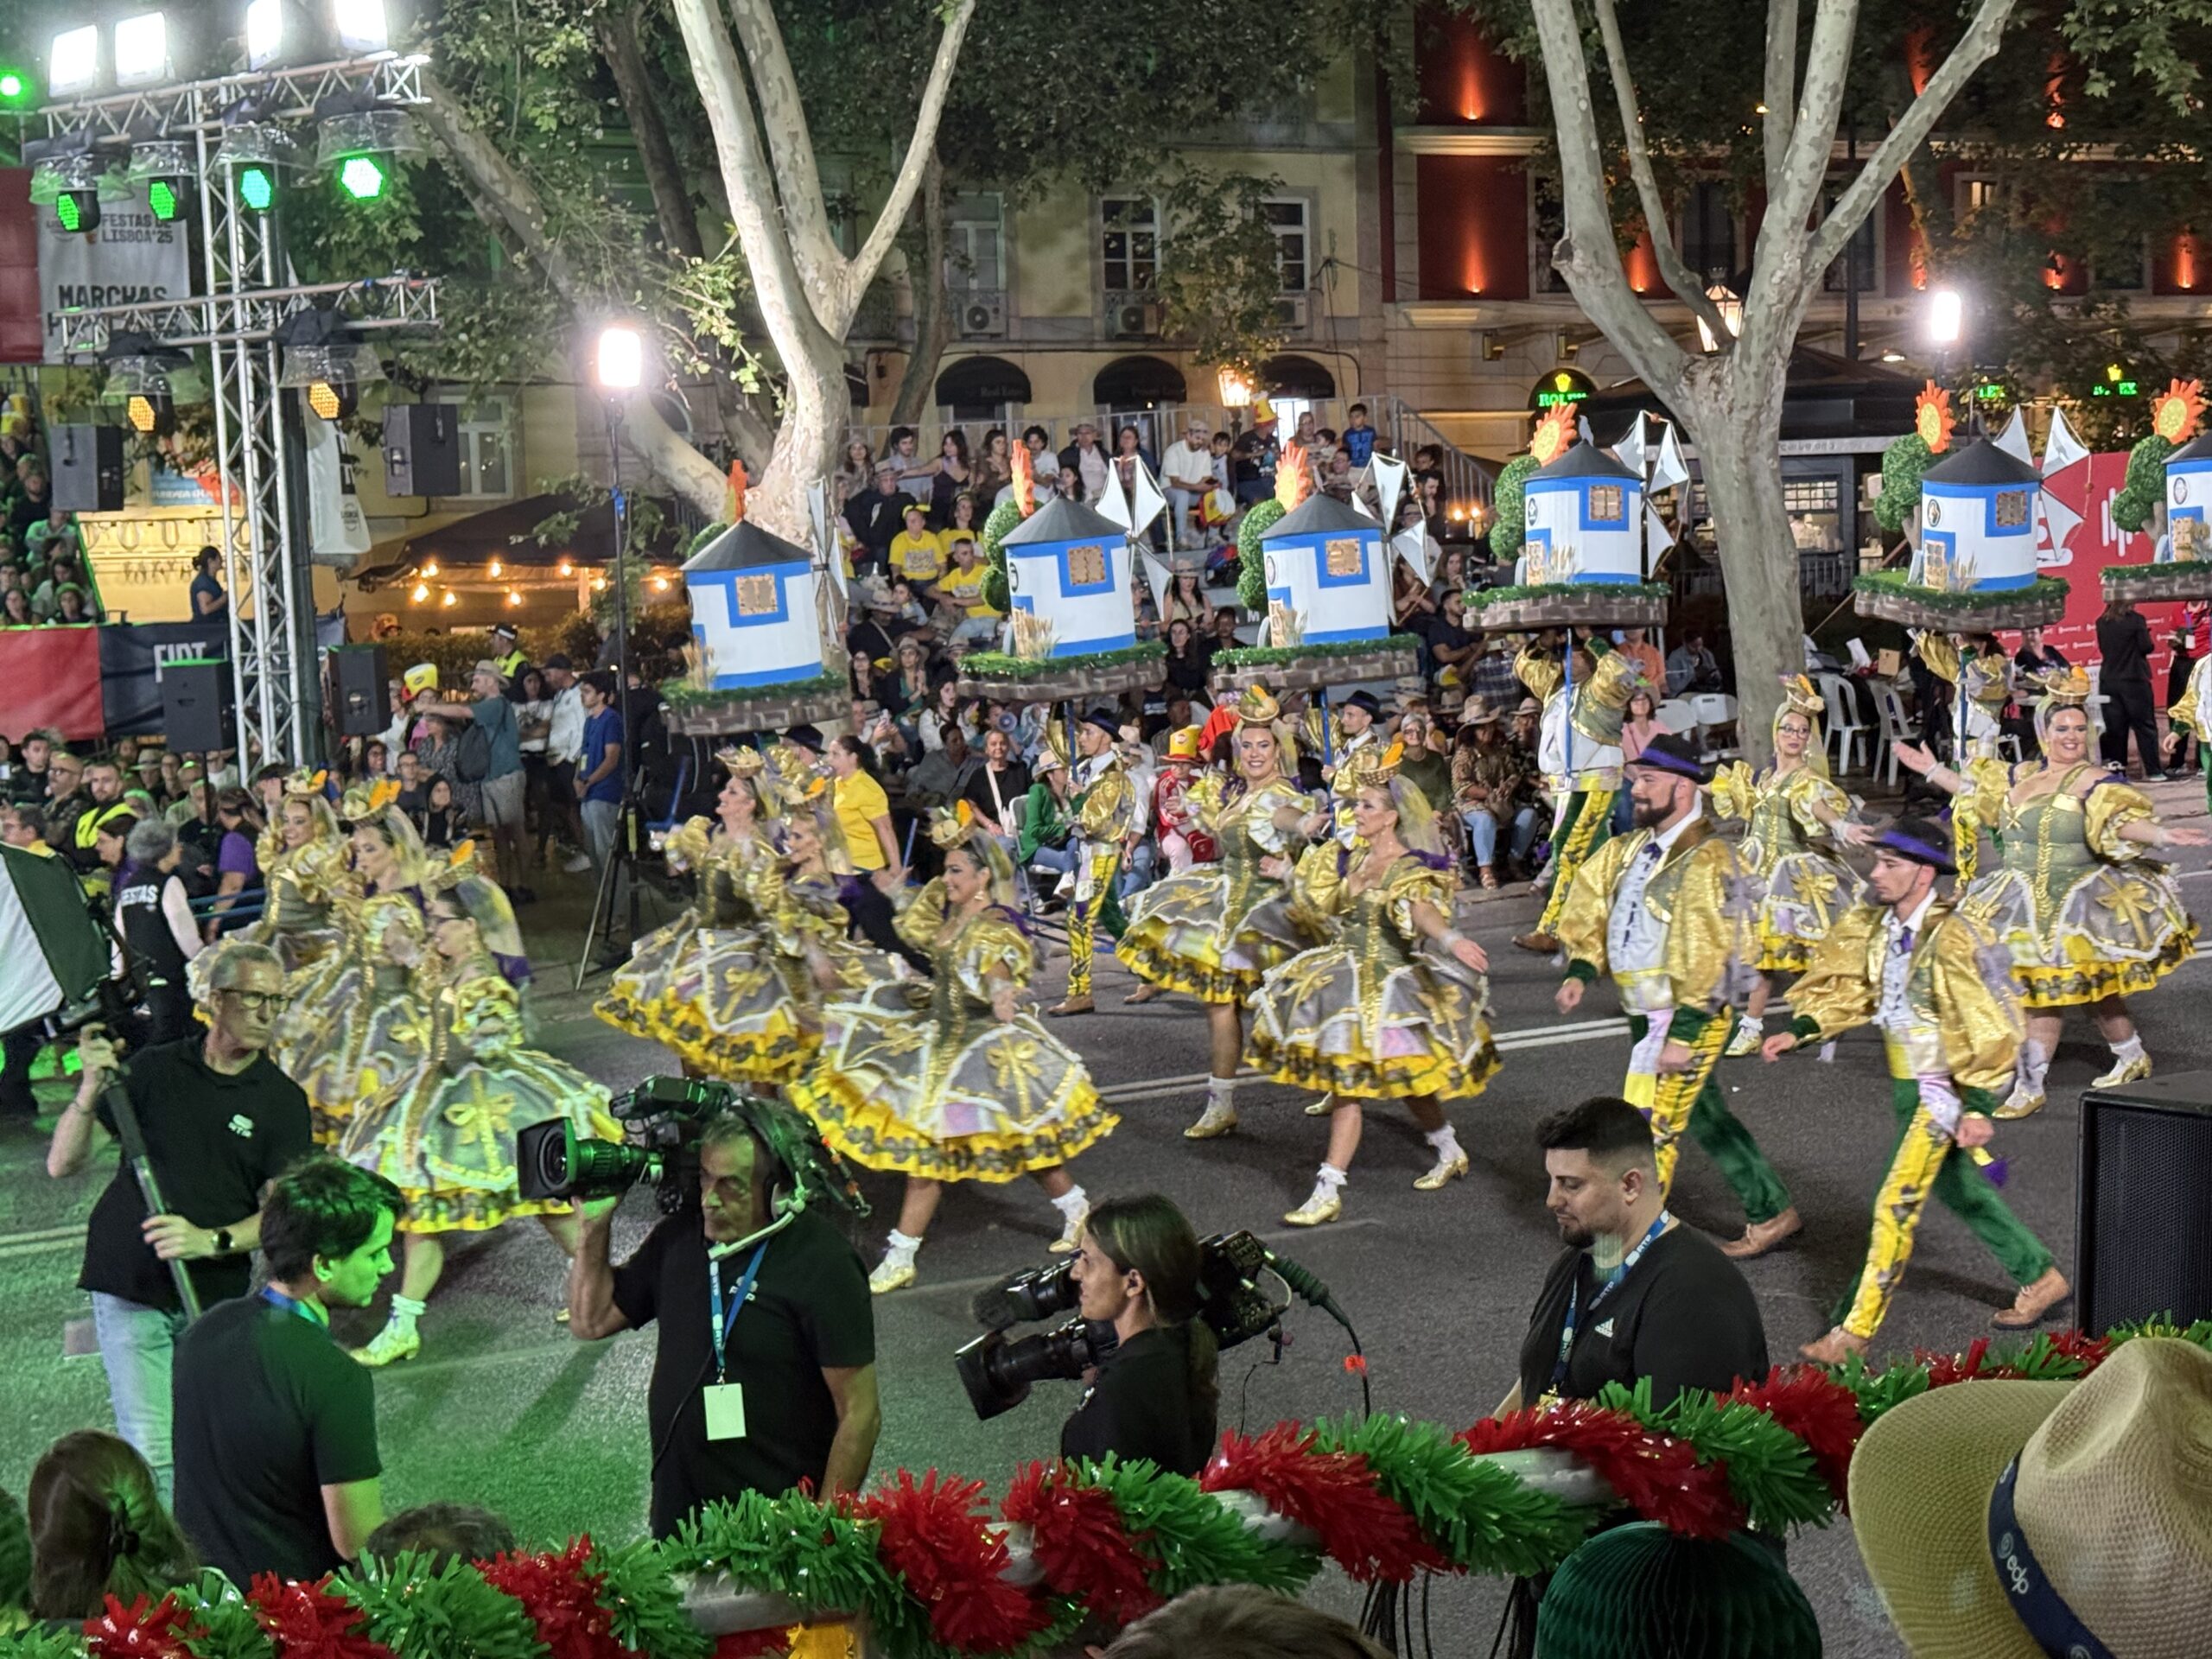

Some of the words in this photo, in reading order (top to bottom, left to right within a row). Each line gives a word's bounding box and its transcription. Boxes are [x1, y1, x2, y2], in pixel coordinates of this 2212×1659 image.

[101, 213, 152, 228] FESTAS
[58, 284, 168, 308] MARCHAS
[728, 1285, 756, 1301] RP
[2005, 1554, 2030, 1595] edp
